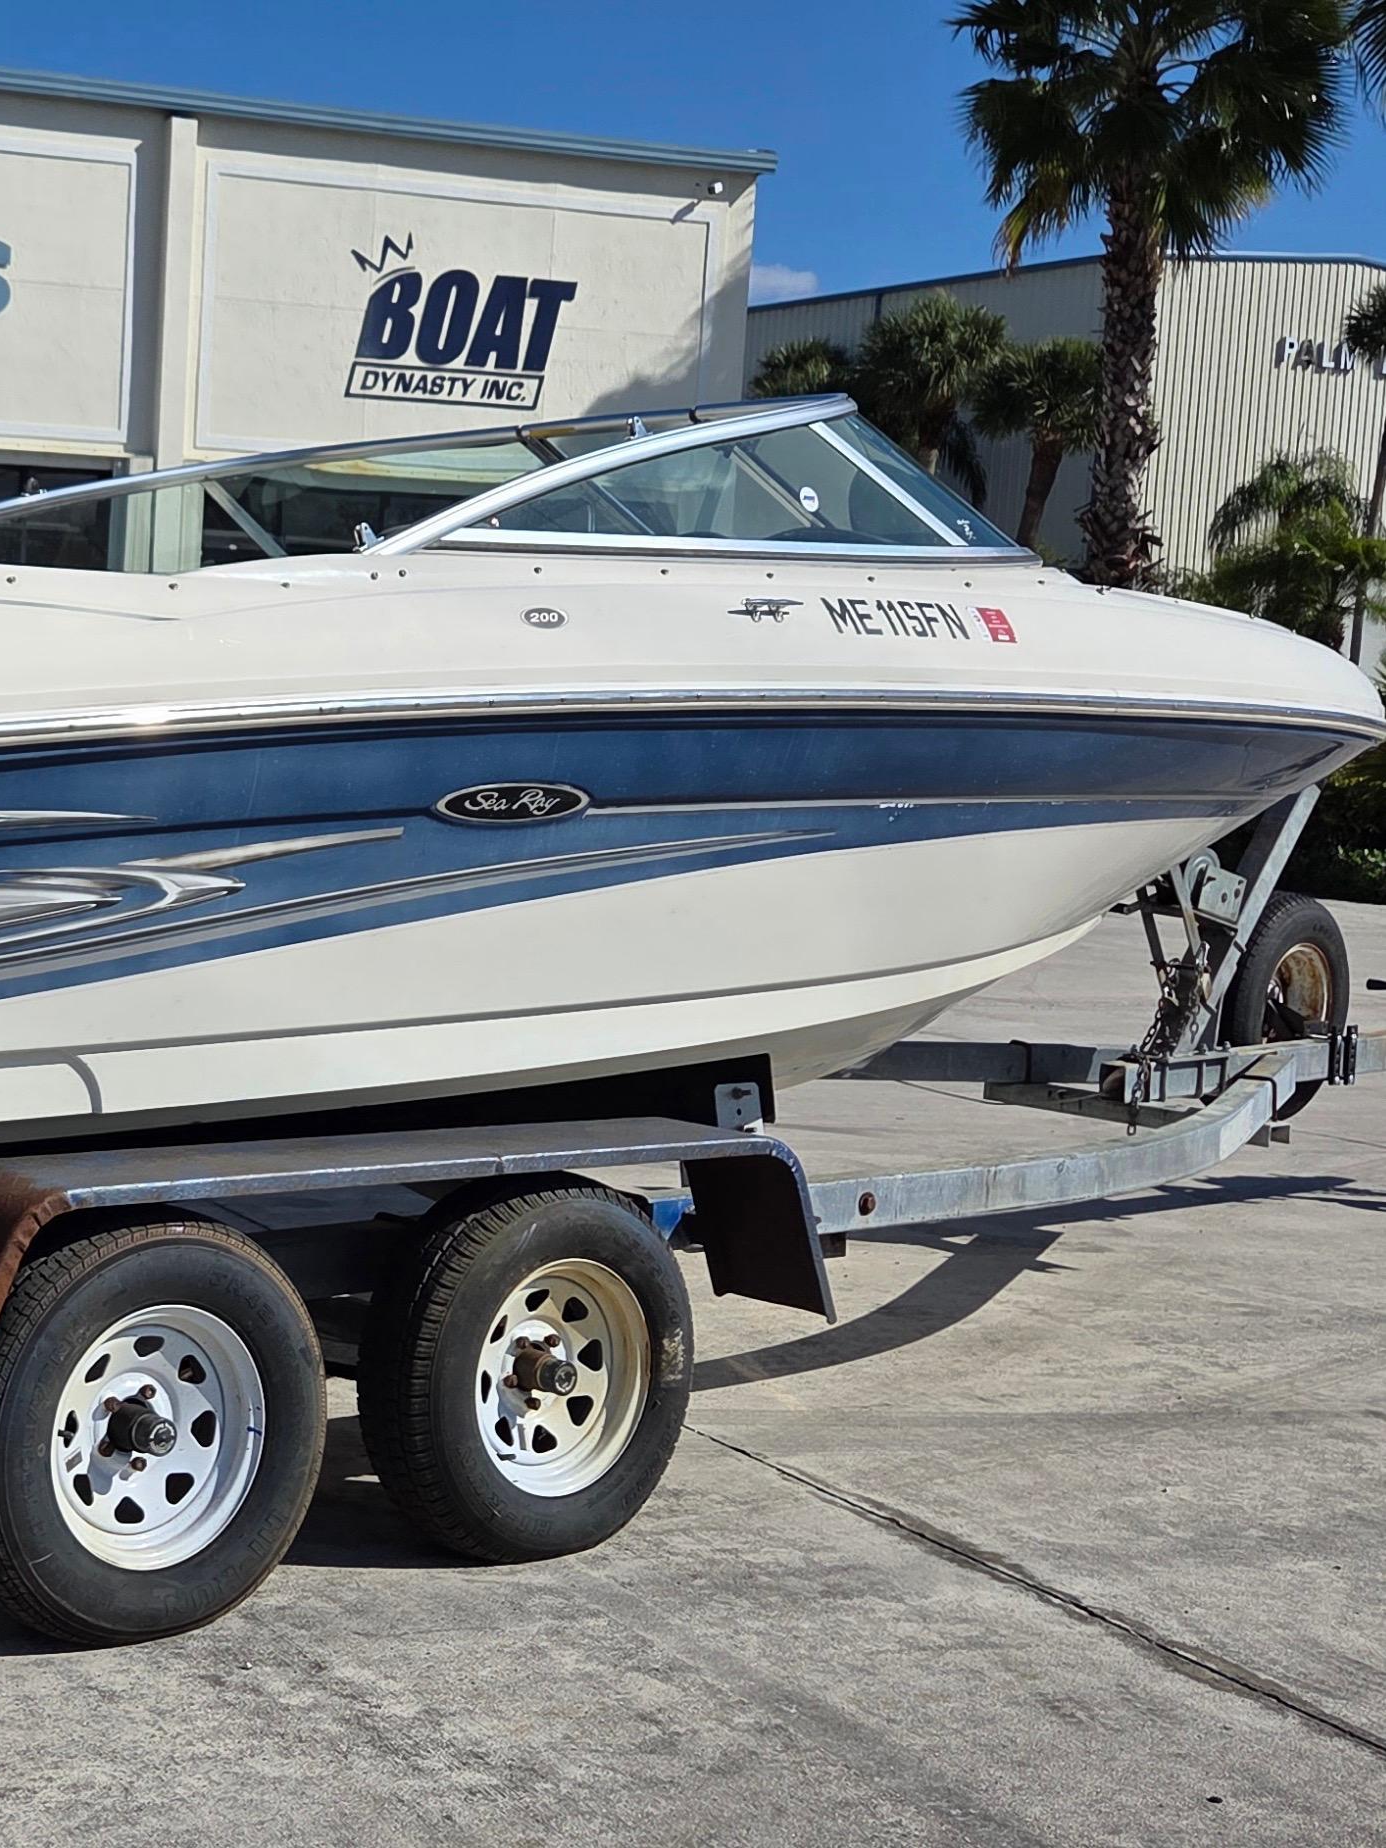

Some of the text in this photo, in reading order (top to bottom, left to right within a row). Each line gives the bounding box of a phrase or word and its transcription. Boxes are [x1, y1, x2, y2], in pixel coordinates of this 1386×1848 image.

[355, 269, 578, 372] BOAT
[360, 370, 527, 402] DYNASTY INC.
[529, 612, 559, 623] 200
[464, 789, 561, 815] Sea Ray
